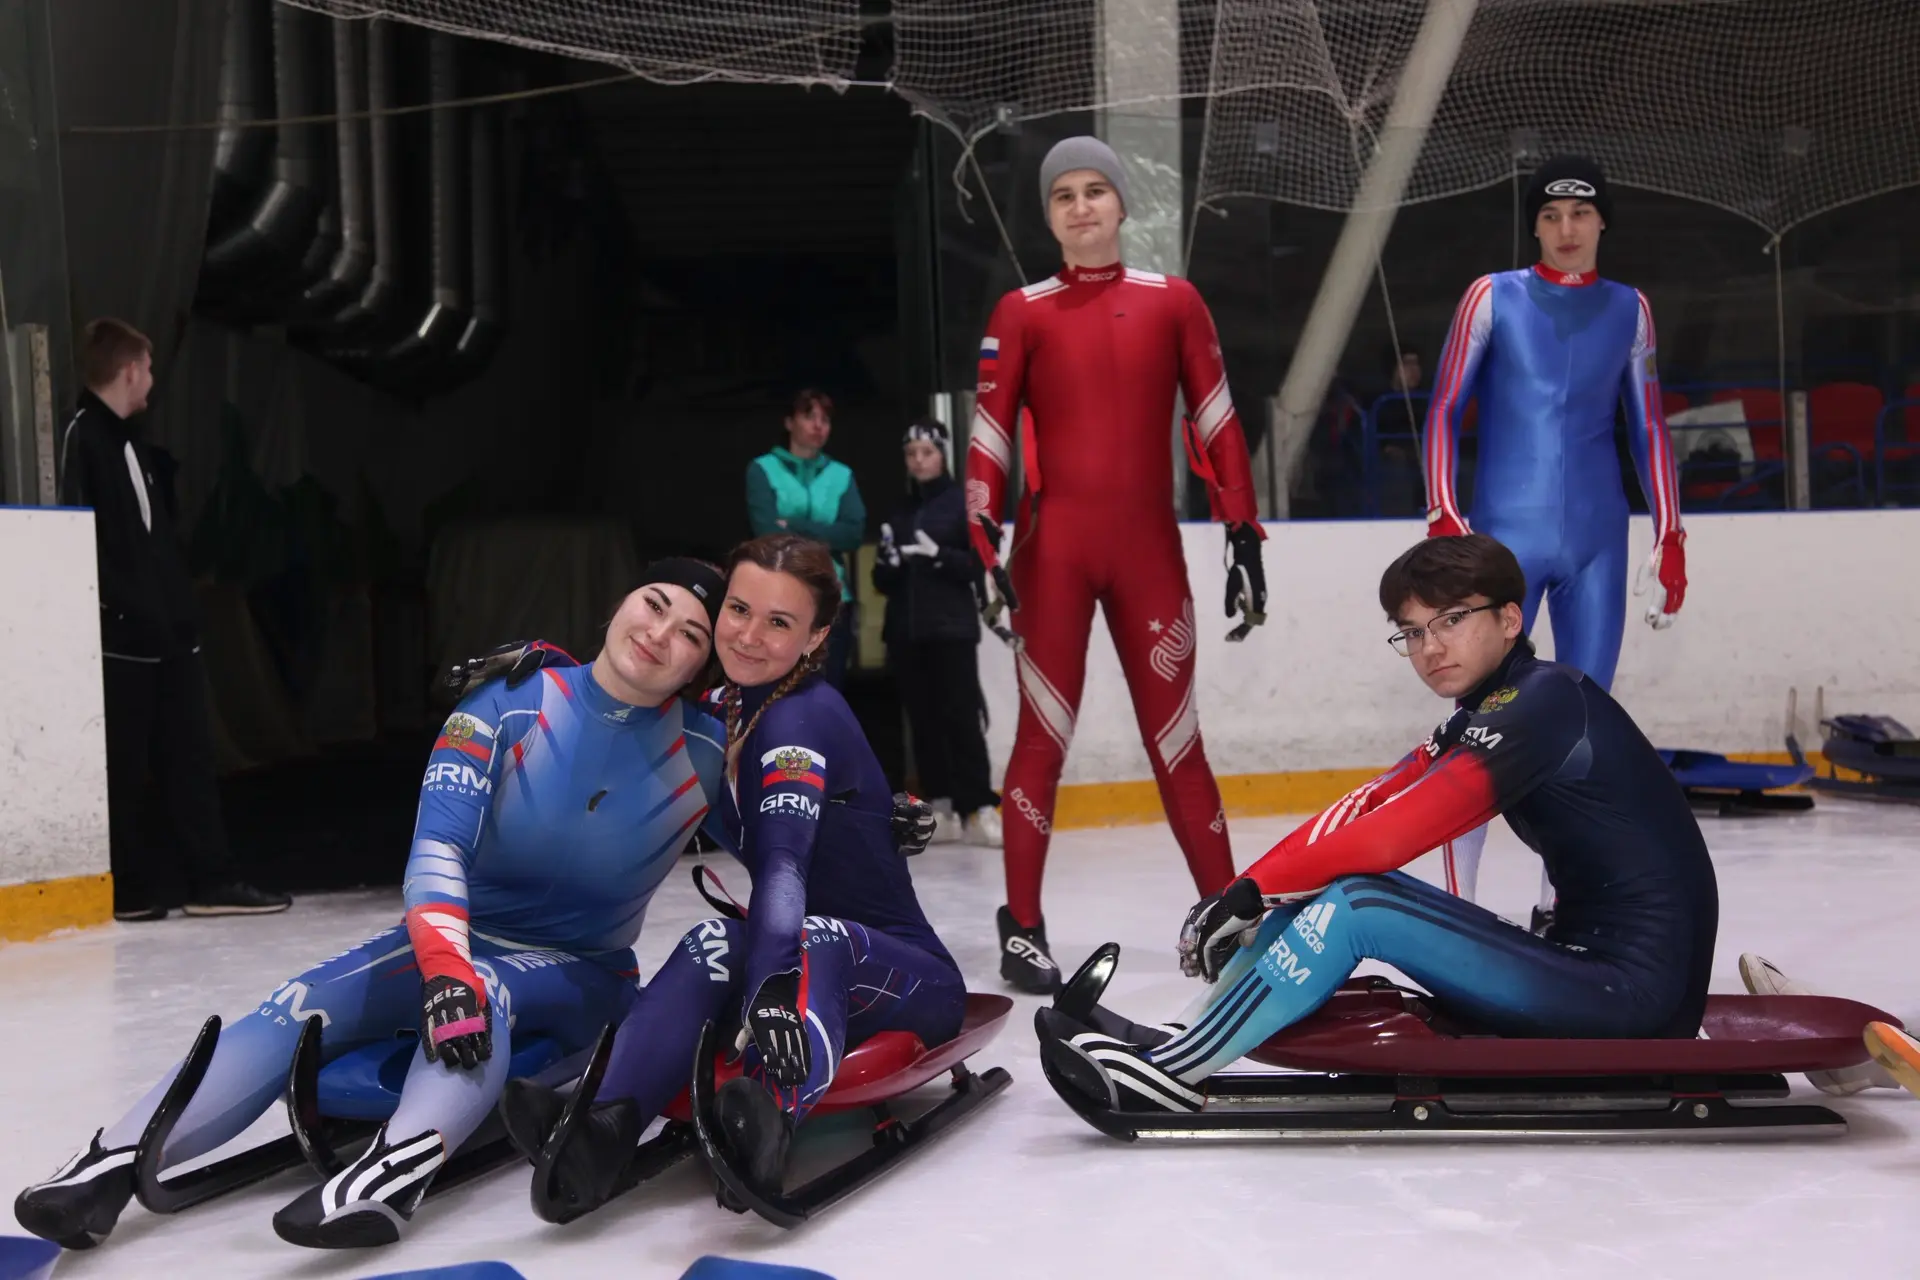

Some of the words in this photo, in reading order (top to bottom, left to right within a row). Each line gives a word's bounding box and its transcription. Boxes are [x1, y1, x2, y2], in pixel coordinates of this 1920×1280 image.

[422, 763, 492, 795] GRM
[428, 784, 478, 796] GROUP
[760, 793, 820, 821] GRM
[769, 809, 811, 820] GROUP
[683, 935, 701, 964] OUP
[689, 918, 730, 982] RM
[802, 934, 839, 950] ROUP
[1006, 936, 1058, 970] GTS
